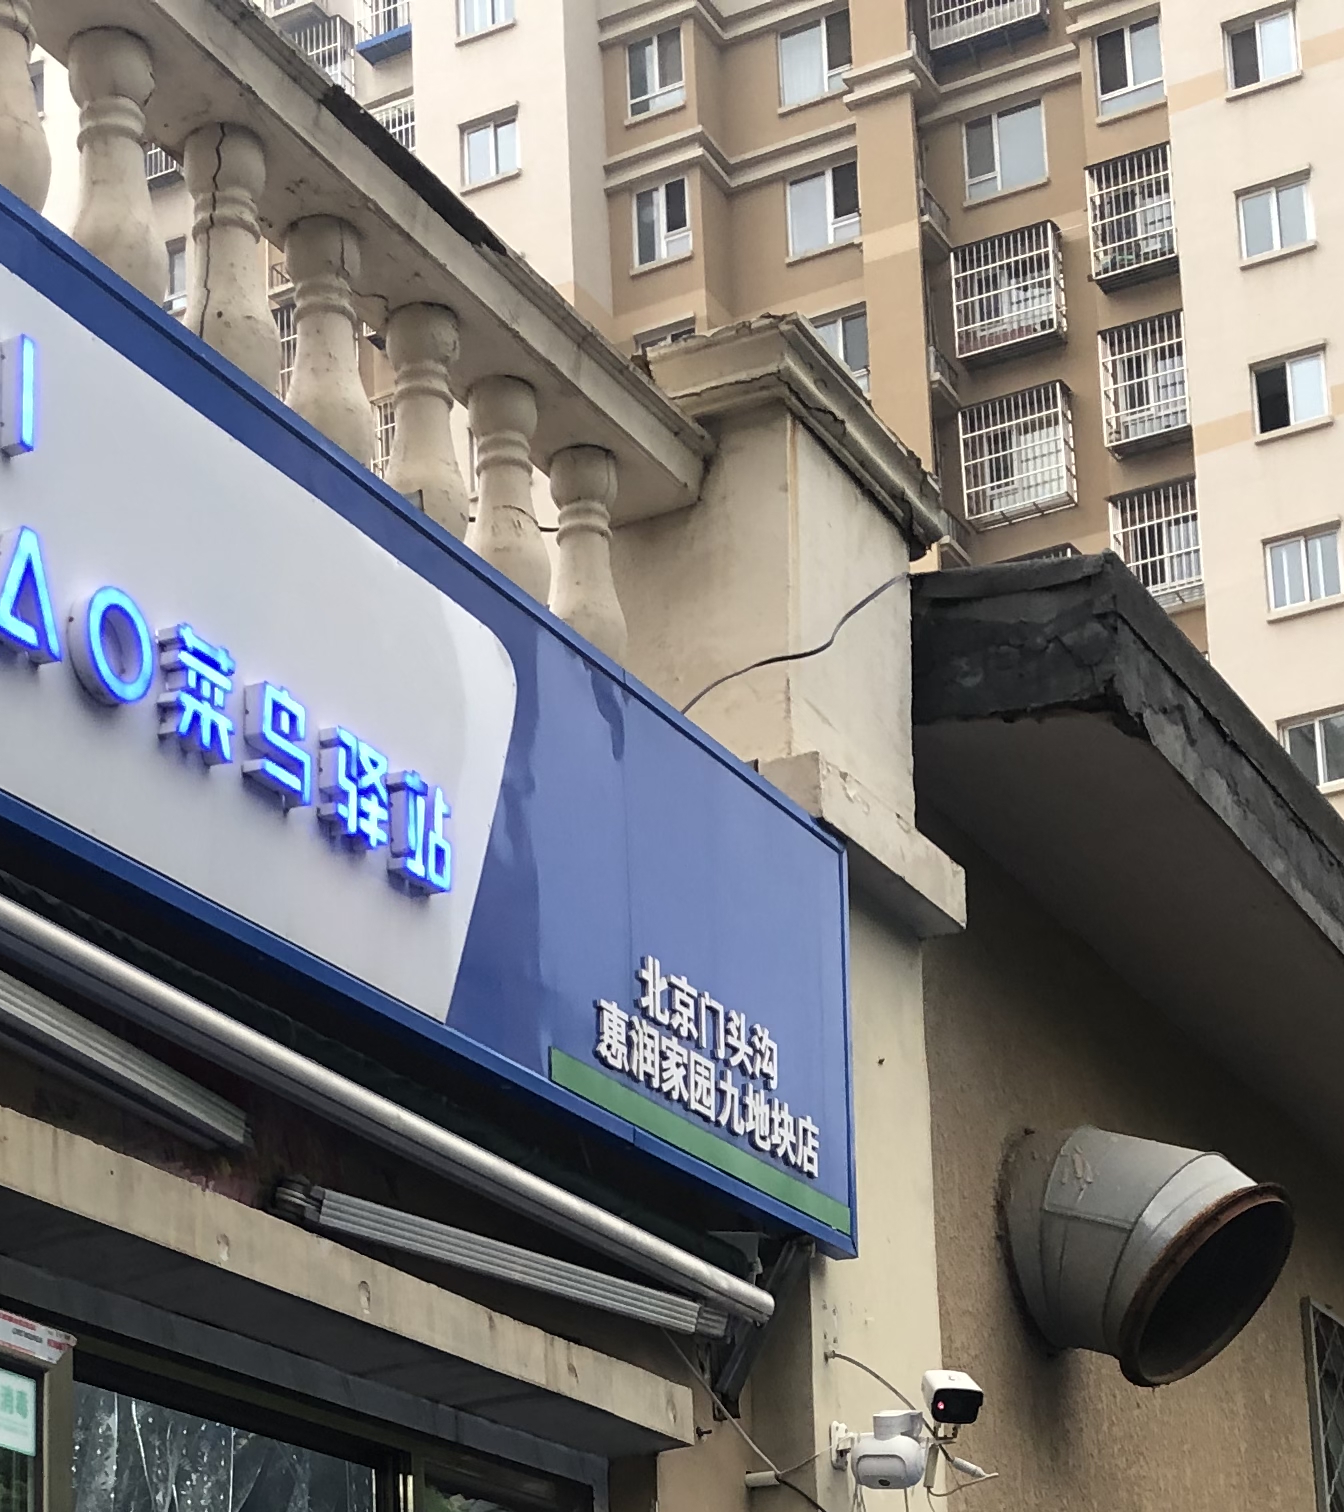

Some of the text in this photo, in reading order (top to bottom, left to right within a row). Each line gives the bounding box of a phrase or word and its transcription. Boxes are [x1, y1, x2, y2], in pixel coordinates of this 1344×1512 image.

[166, 622, 453, 895] 菜鸟驿站
[594, 998, 820, 1178] 惠润家园九地块店
[638, 955, 779, 1090] 北京门头沟
